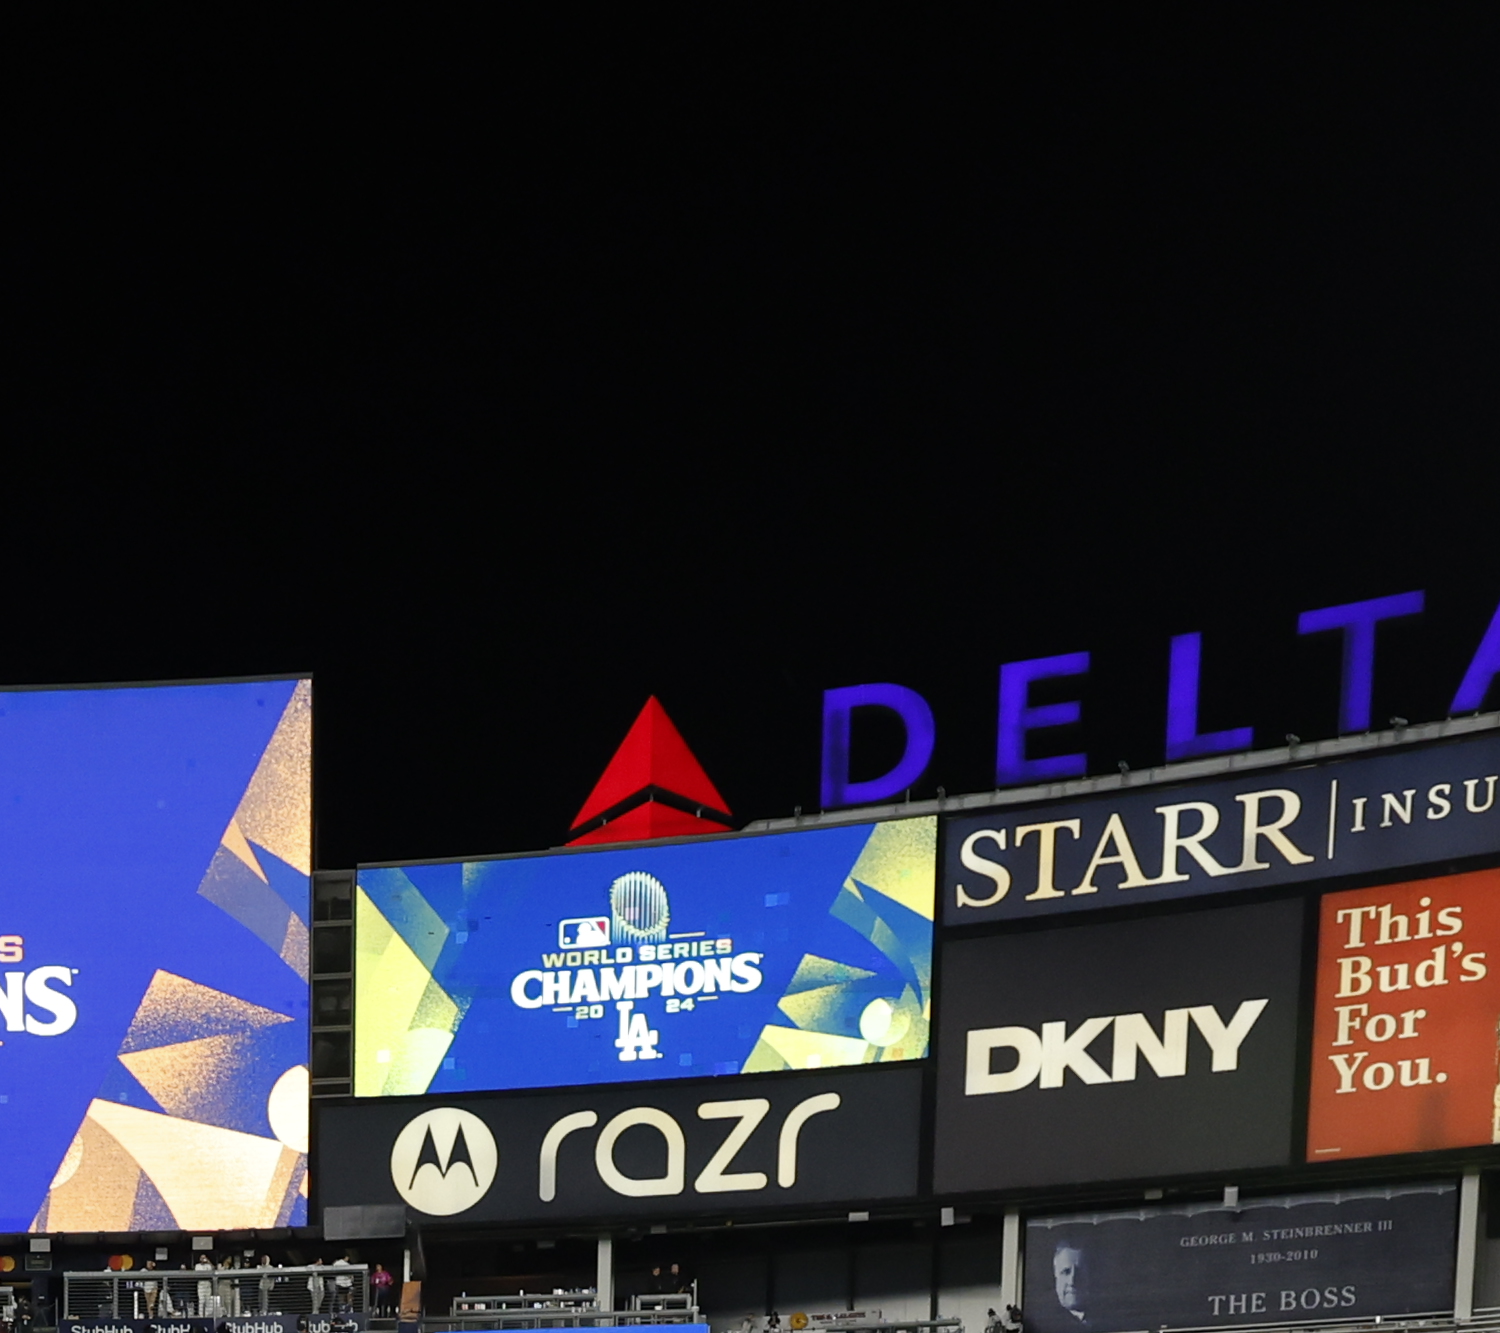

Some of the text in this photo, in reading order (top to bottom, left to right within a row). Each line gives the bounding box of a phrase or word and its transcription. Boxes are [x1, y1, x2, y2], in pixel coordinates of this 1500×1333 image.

[955, 788, 1314, 908] STARR
[1337, 898, 1463, 949] This
[542, 939, 732, 968] WORLD SERIES
[1335, 942, 1487, 998] Bud's
[510, 952, 763, 1009] CHAMPIONS
[574, 998, 694, 1019] 20 24
[615, 1001, 659, 1060] LA
[1332, 1003, 1426, 1047] For
[964, 999, 1269, 1096] DKNY
[1330, 1054, 1447, 1094] You.
[539, 1092, 841, 1201] razr
[1180, 1233, 1236, 1248] GEORGE
[1263, 1222, 1374, 1241] STEINBRENNER
[1378, 1220, 1393, 1232] III
[1250, 1249, 1319, 1264] 1930-2010
[1208, 1286, 1357, 1315] THE BOSS
